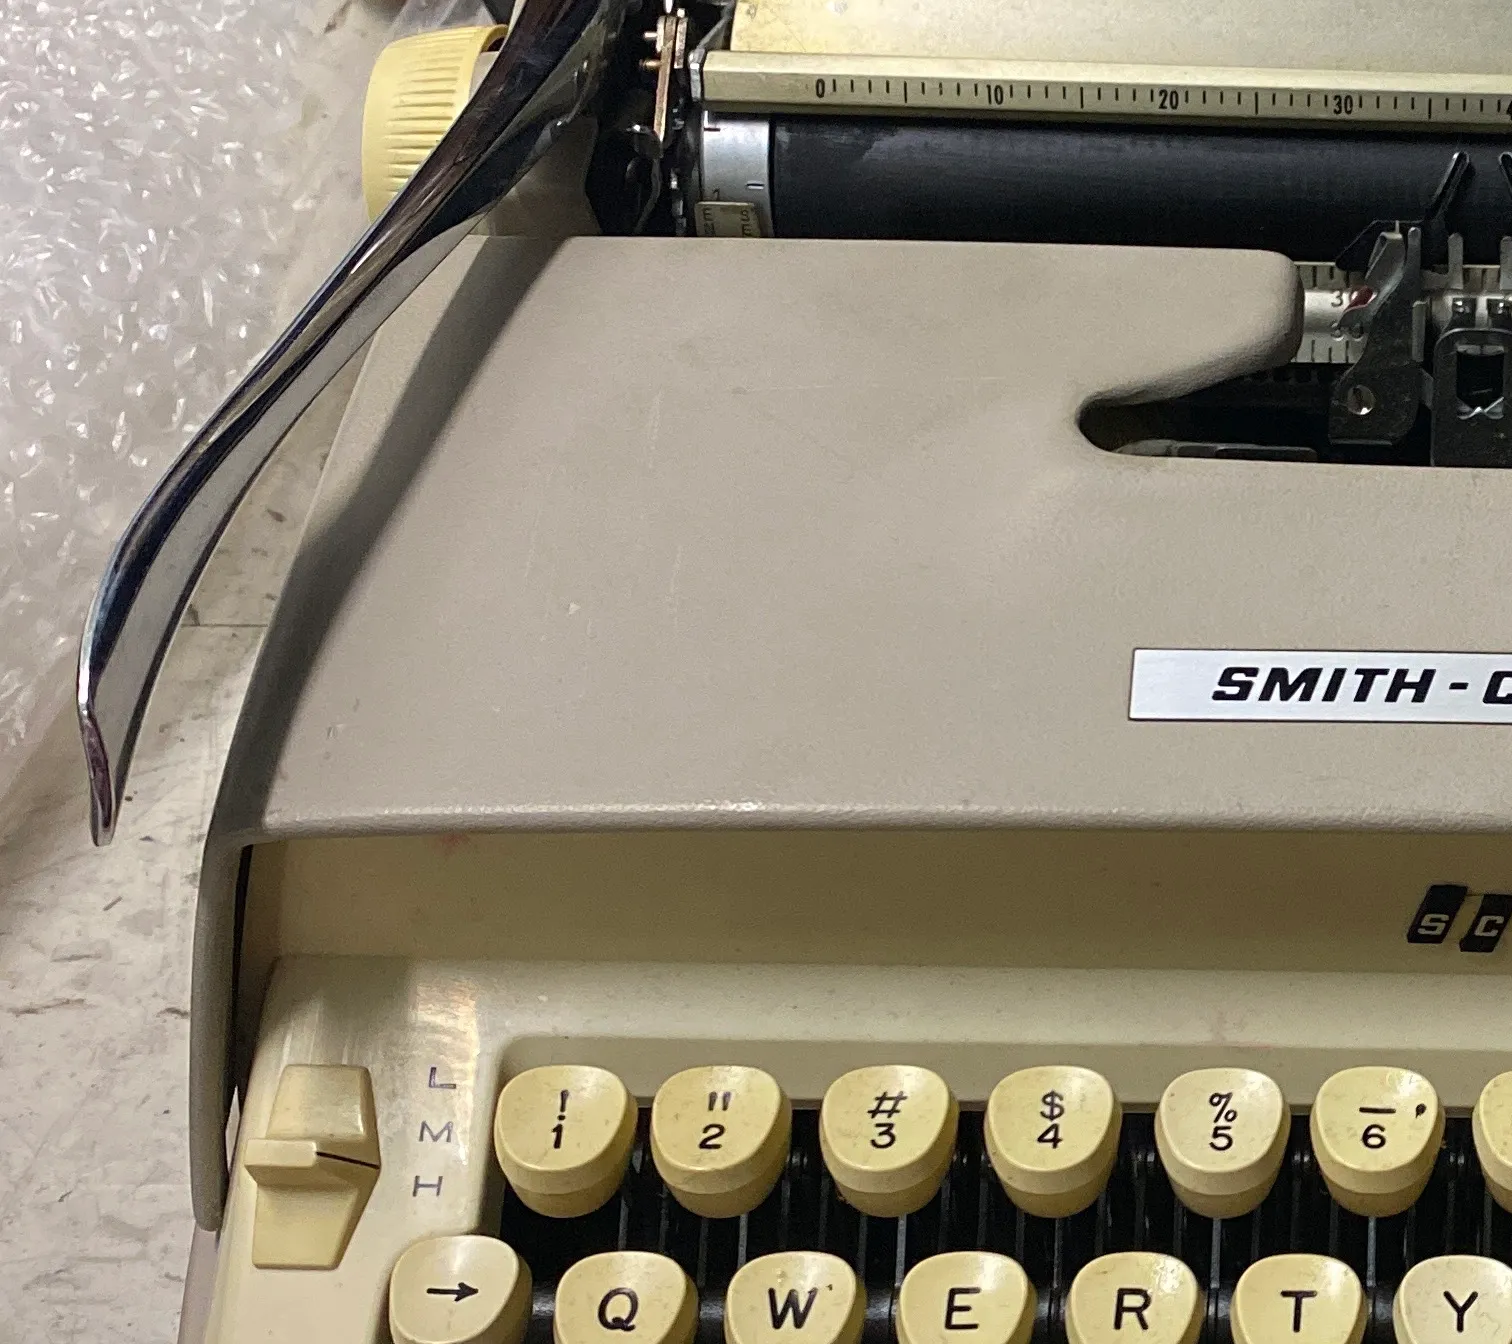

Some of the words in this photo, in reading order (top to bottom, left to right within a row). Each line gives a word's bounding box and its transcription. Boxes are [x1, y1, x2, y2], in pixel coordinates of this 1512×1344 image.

[815, 78, 825, 98] 0
[986, 84, 1004, 105] 10
[1159, 89, 1179, 110] 20
[1333, 94, 1353, 115] 30
[429, 1066, 456, 1089] L
[559, 1089, 570, 1121] !
[708, 1091, 732, 1112] "
[867, 1091, 908, 1117] #
[1039, 1090, 1065, 1122] $
[1208, 1092, 1238, 1123] %
[419, 1121, 453, 1143] M
[699, 1124, 726, 1150] 2
[870, 1123, 896, 1149] 3
[1036, 1124, 1063, 1149] 4
[1208, 1126, 1233, 1151] 5
[1361, 1124, 1386, 1149] 6
[412, 1175, 443, 1197] H
[598, 1287, 639, 1331] Q
[768, 1287, 818, 1330] W
[944, 1287, 980, 1330] E
[1114, 1287, 1151, 1331] R
[1280, 1289, 1318, 1333] T
[1443, 1290, 1479, 1333] Y
